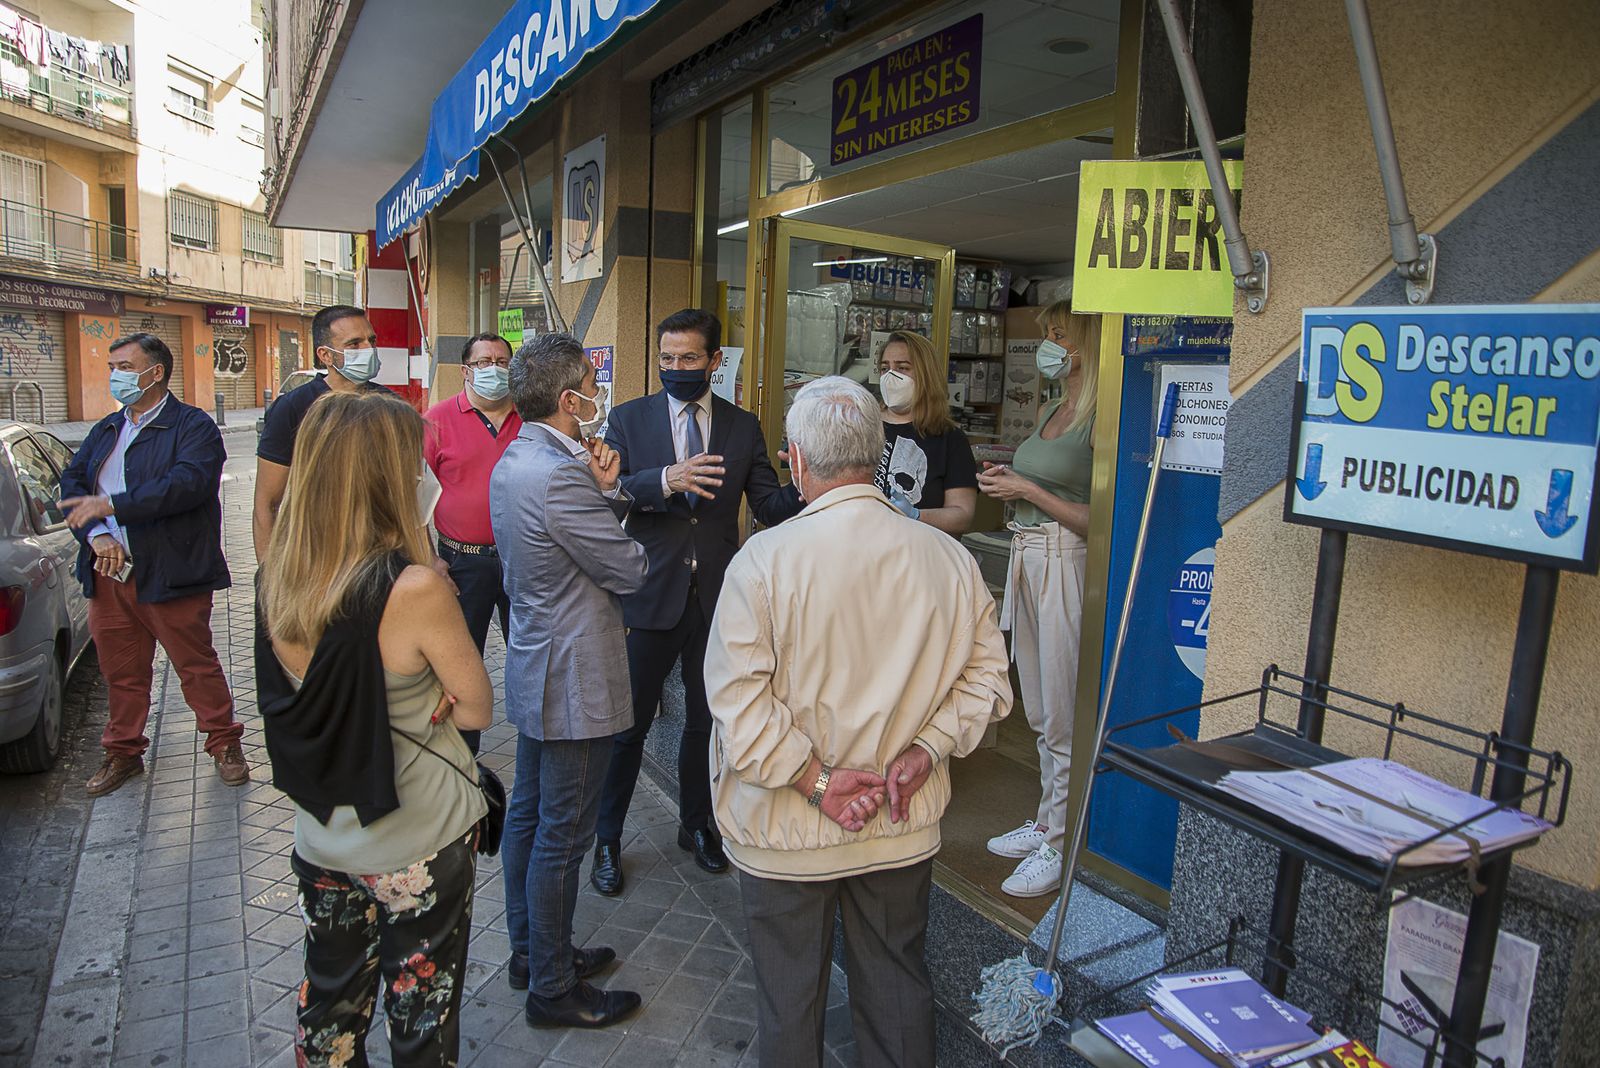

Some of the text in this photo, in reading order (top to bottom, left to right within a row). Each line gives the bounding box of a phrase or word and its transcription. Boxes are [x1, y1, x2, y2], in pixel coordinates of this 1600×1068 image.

[887, 43, 922, 76] PAGA
[924, 37, 943, 60] EN
[834, 51, 971, 137] 24 MESES
[834, 100, 971, 162] SIN INTERESES
[1088, 187, 1242, 272] ABIER
[853, 263, 926, 290] BULTEX
[0, 292, 33, 305] SUTERIA
[39, 296, 85, 310] DECORACION
[13, 281, 45, 294] SECOS
[51, 286, 106, 302] COMPLEMENTOS
[1187, 337, 1221, 346] muebles
[1305, 321, 1600, 424] DS Descanso
[1171, 381, 1213, 392] FERTAS
[1176, 399, 1229, 411] OLCHONES
[1426, 379, 1557, 438] Stelar
[1172, 414, 1226, 426] CONOMICO
[1192, 431, 1224, 440] ESTUDIA
[1341, 456, 1520, 512] PUBLICIDAD
[1192, 597, 1206, 606] Hasta
